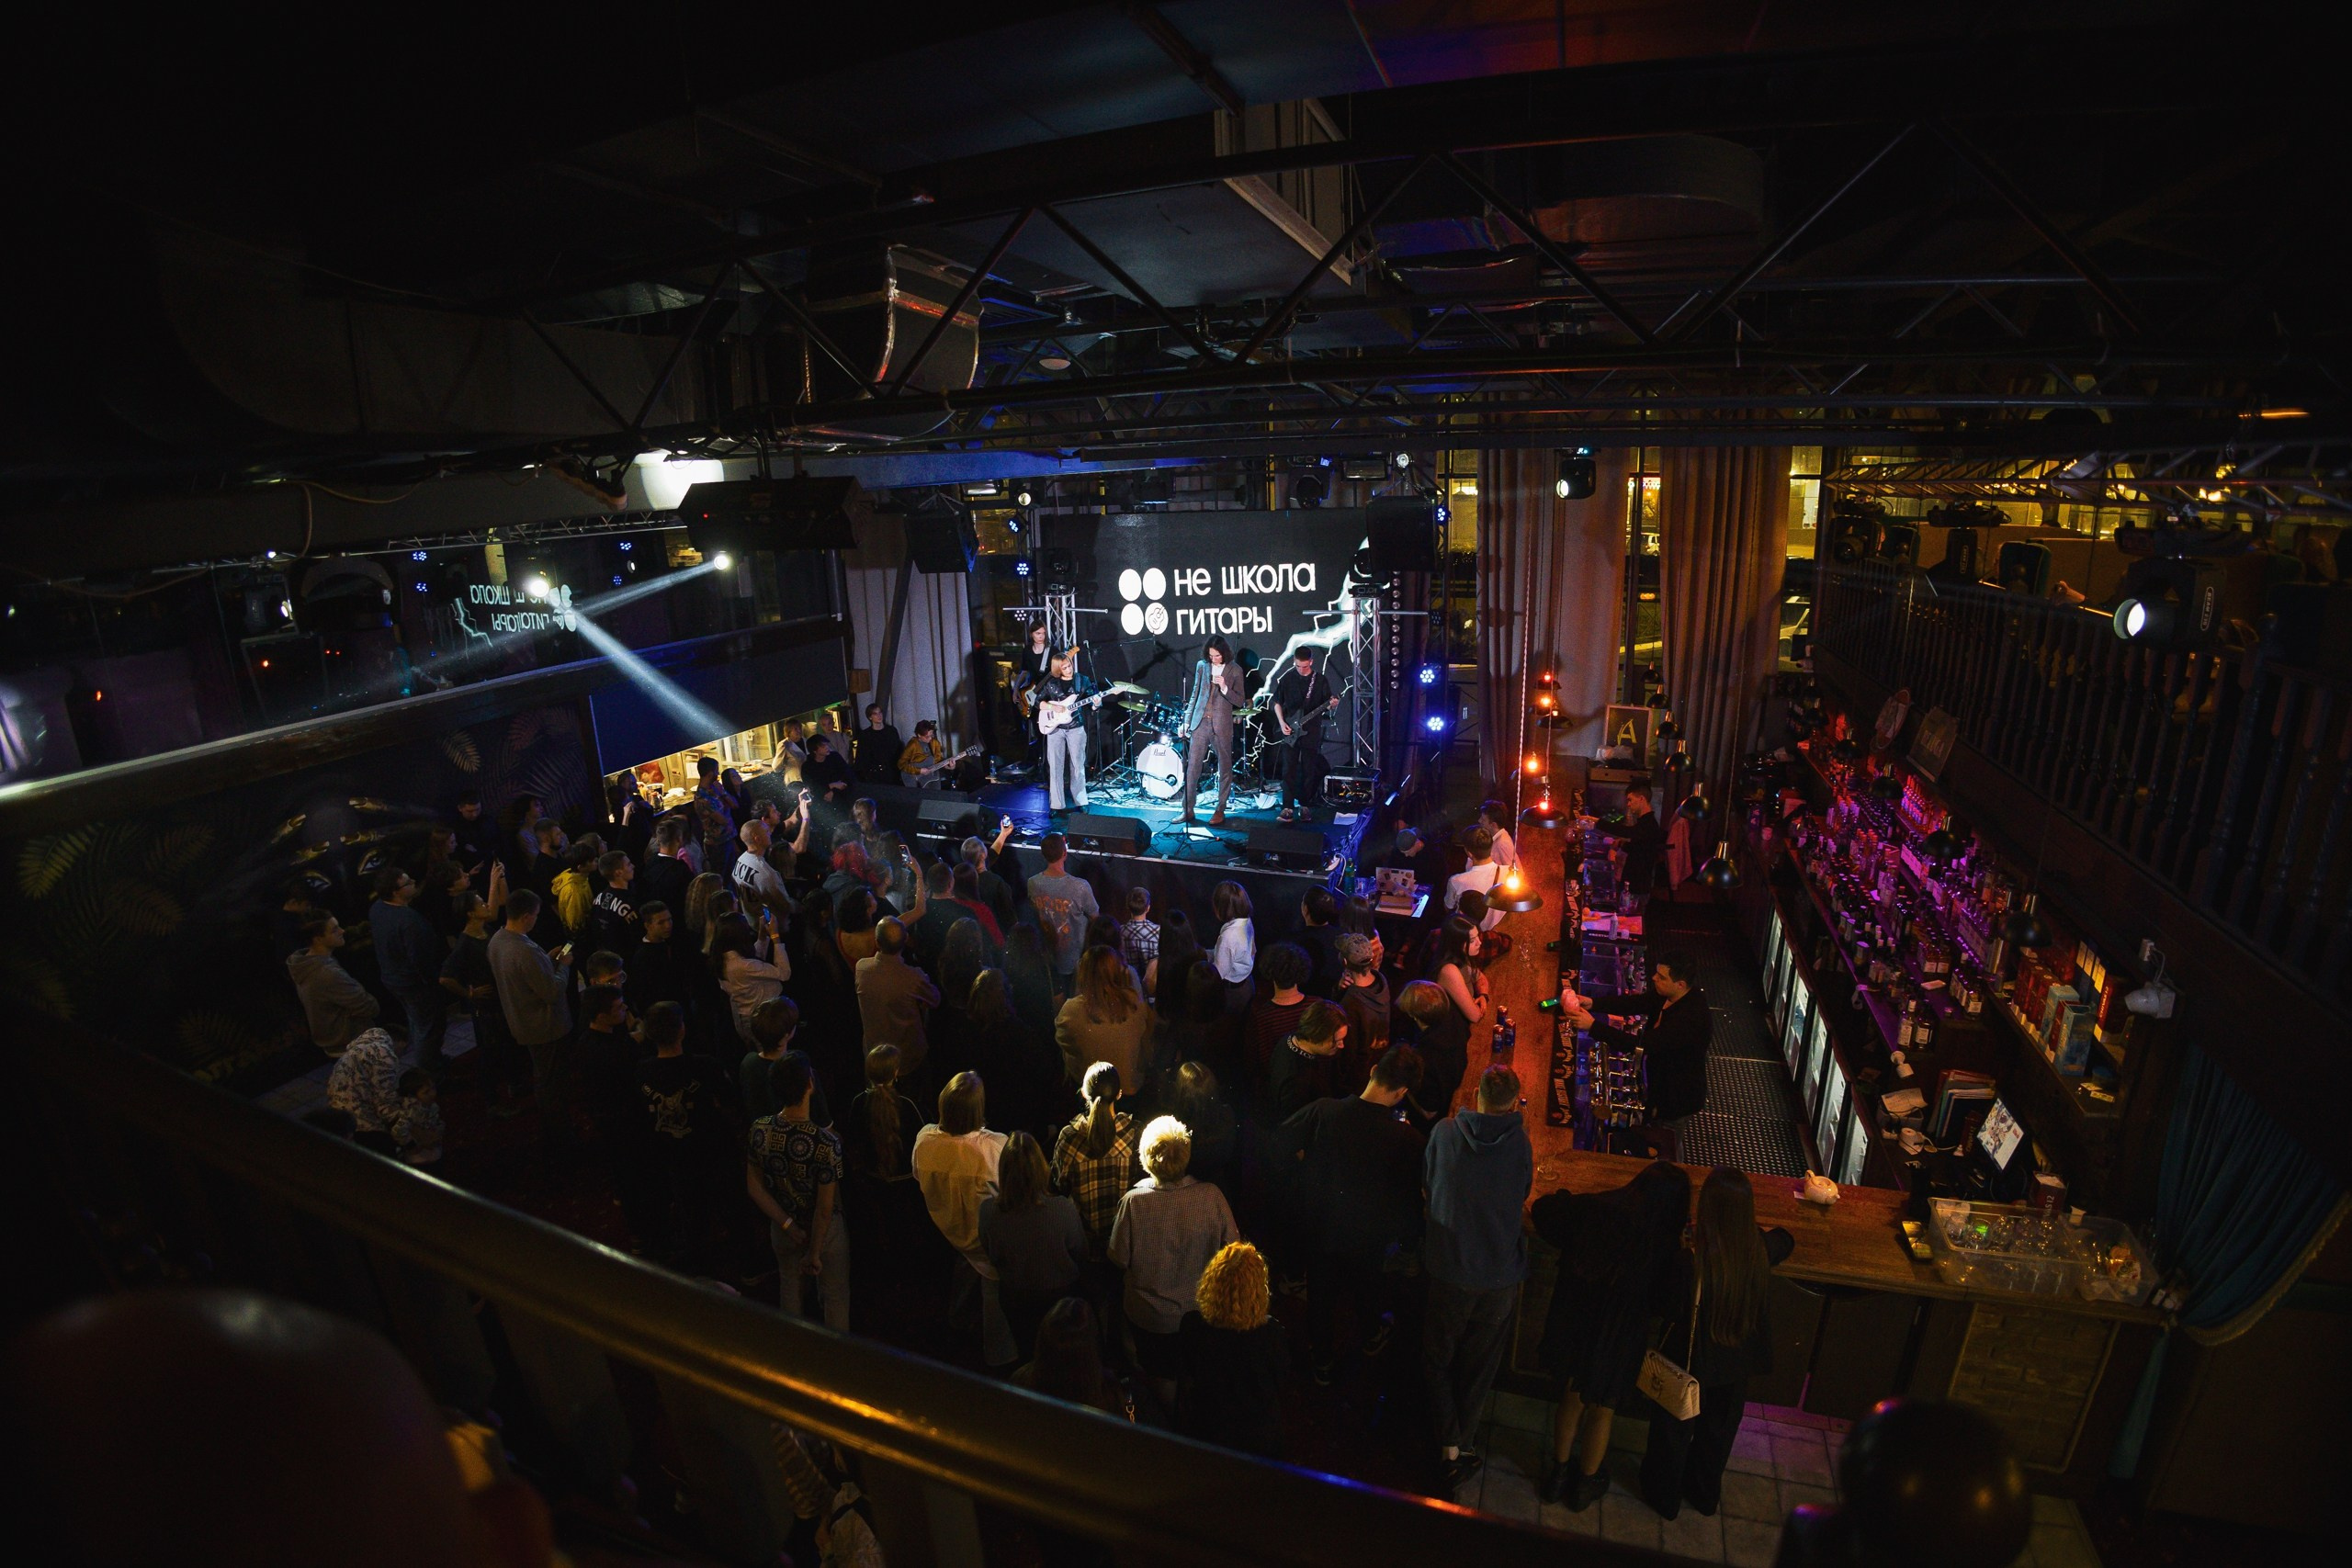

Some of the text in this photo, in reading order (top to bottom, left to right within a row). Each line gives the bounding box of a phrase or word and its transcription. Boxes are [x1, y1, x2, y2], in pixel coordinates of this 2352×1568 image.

[1221, 562, 1317, 595] школа
[1176, 605, 1273, 636] гитары
[733, 860, 760, 886] UCK
